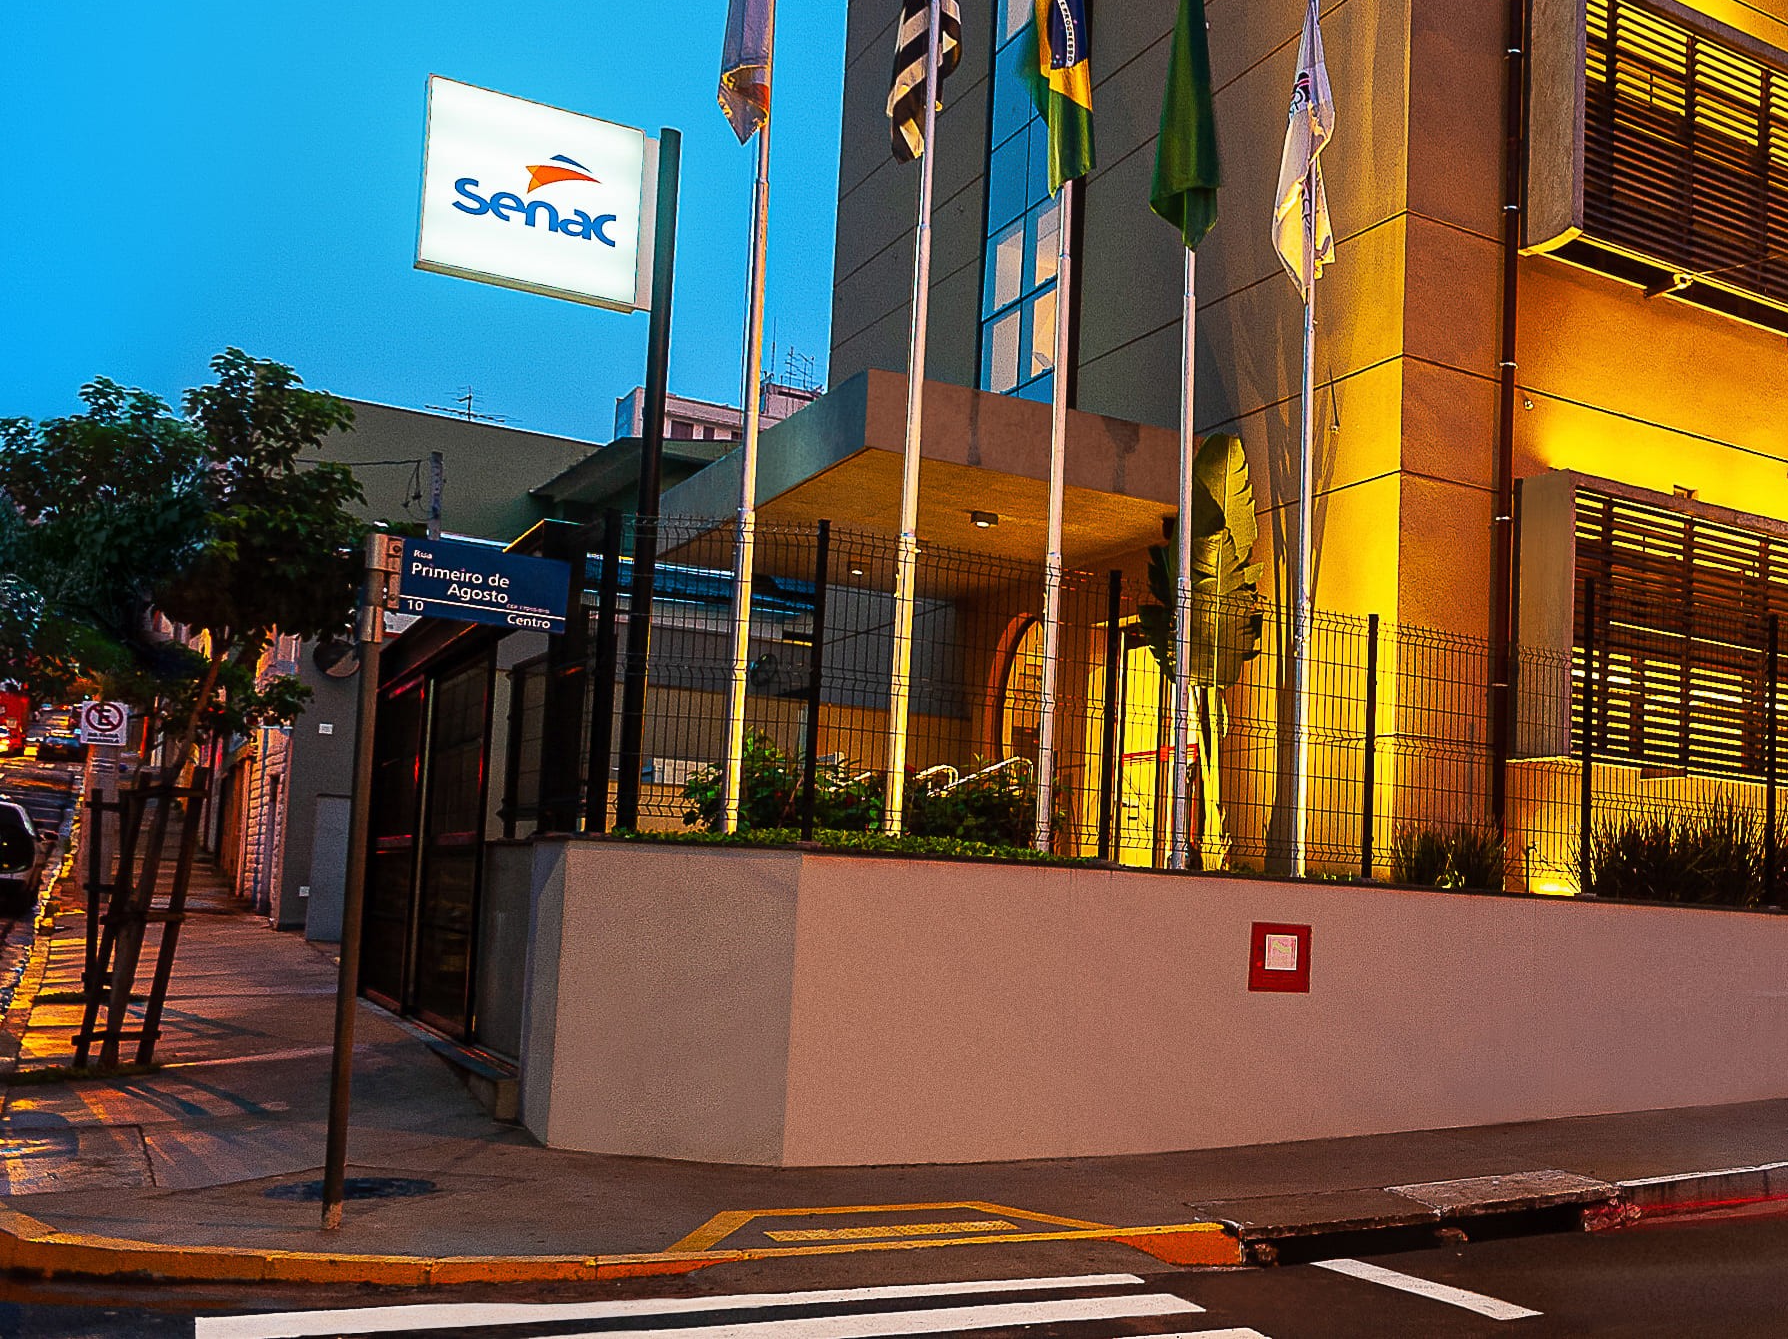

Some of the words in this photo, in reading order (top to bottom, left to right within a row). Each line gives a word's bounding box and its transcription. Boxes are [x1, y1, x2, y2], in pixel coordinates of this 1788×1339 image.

[451, 177, 617, 248] Senac
[413, 549, 433, 560] Rua
[411, 562, 483, 584] Primeiro
[488, 573, 510, 588] de
[447, 583, 508, 603] Agosto
[407, 599, 424, 611] 10
[507, 614, 551, 629] Centro
